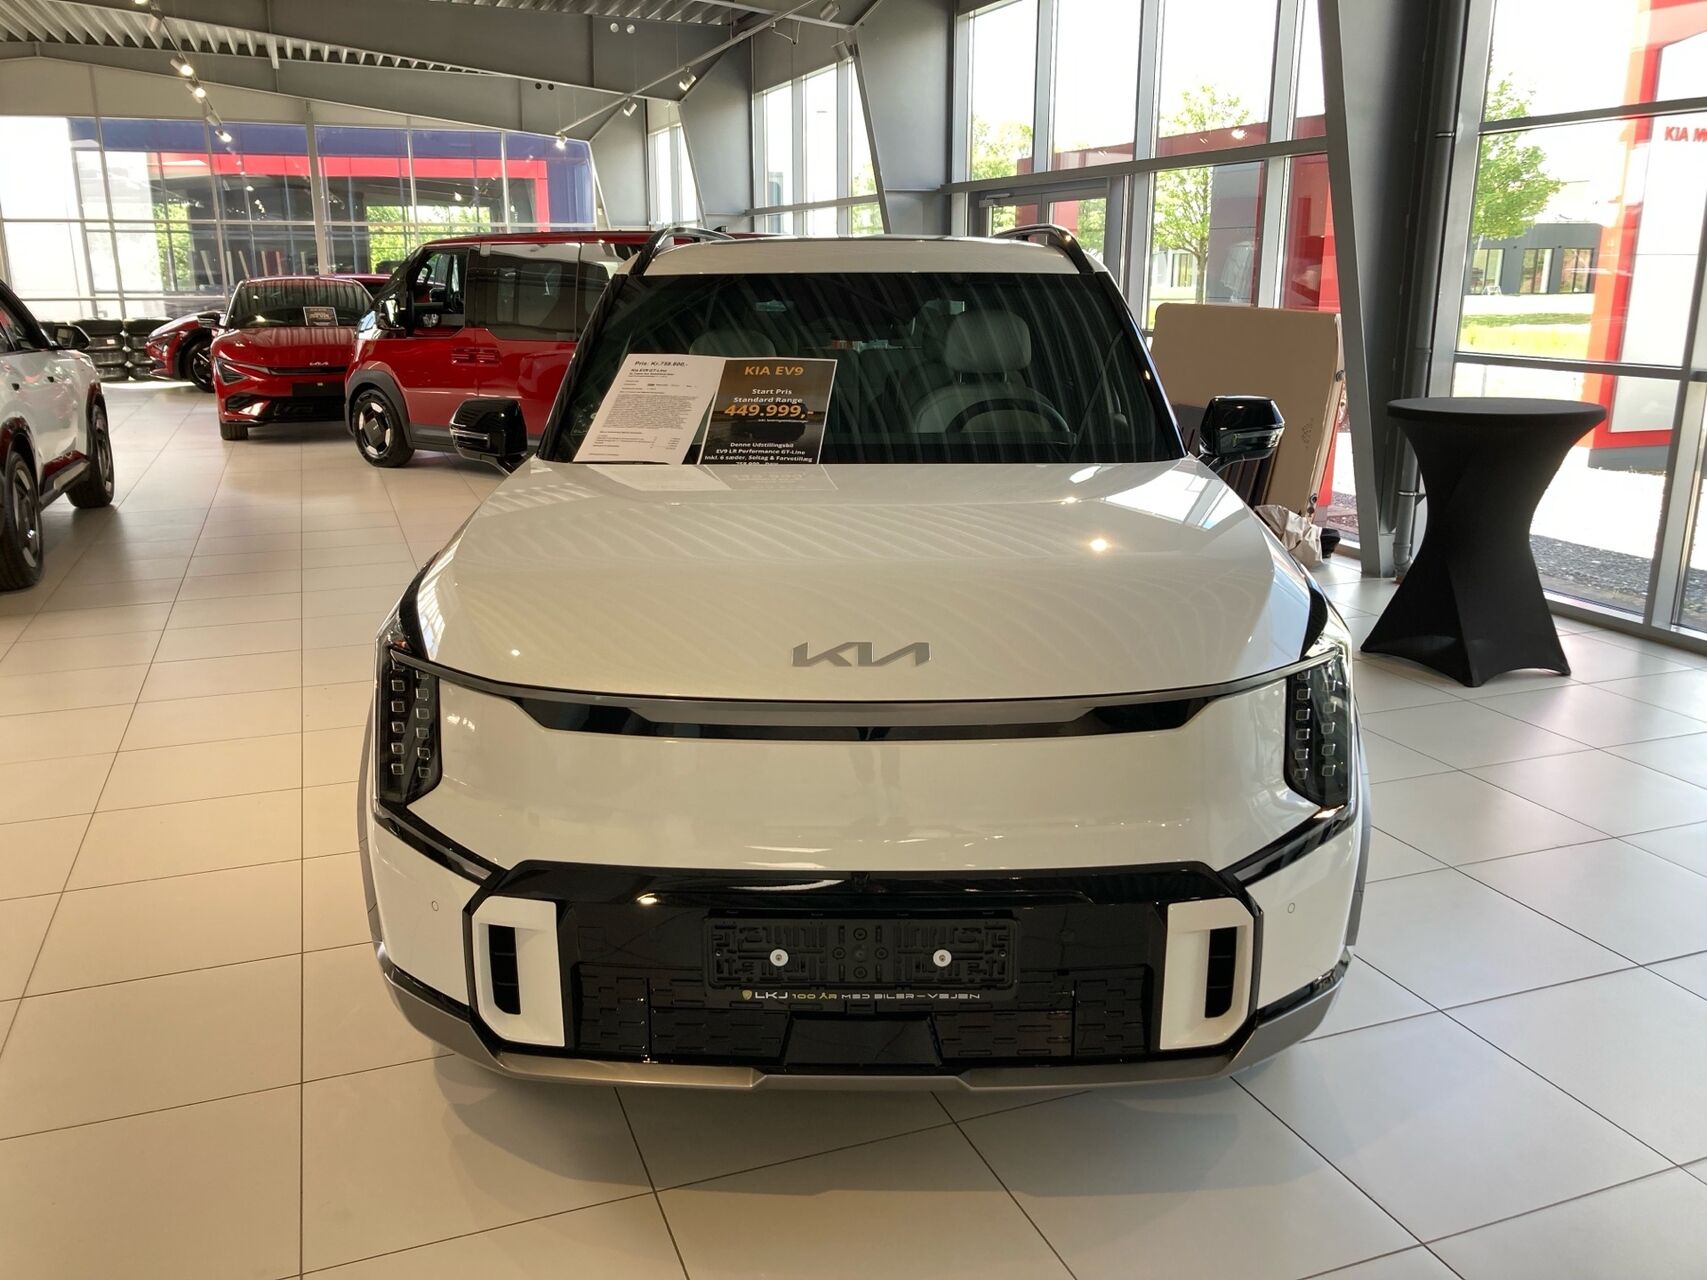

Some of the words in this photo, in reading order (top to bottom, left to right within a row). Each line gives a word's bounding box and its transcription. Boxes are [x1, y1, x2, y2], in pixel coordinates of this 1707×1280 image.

[1664, 126, 1689, 142] KIA
[1693, 127, 1707, 142] M
[744, 366, 771, 376] KIA
[774, 366, 804, 376] EV9
[733, 396, 774, 404] Standard
[775, 397, 803, 405] Range
[724, 404, 814, 419] 449.999,-
[754, 992, 789, 1000] LKJ
[819, 992, 838, 1000] ÅR
